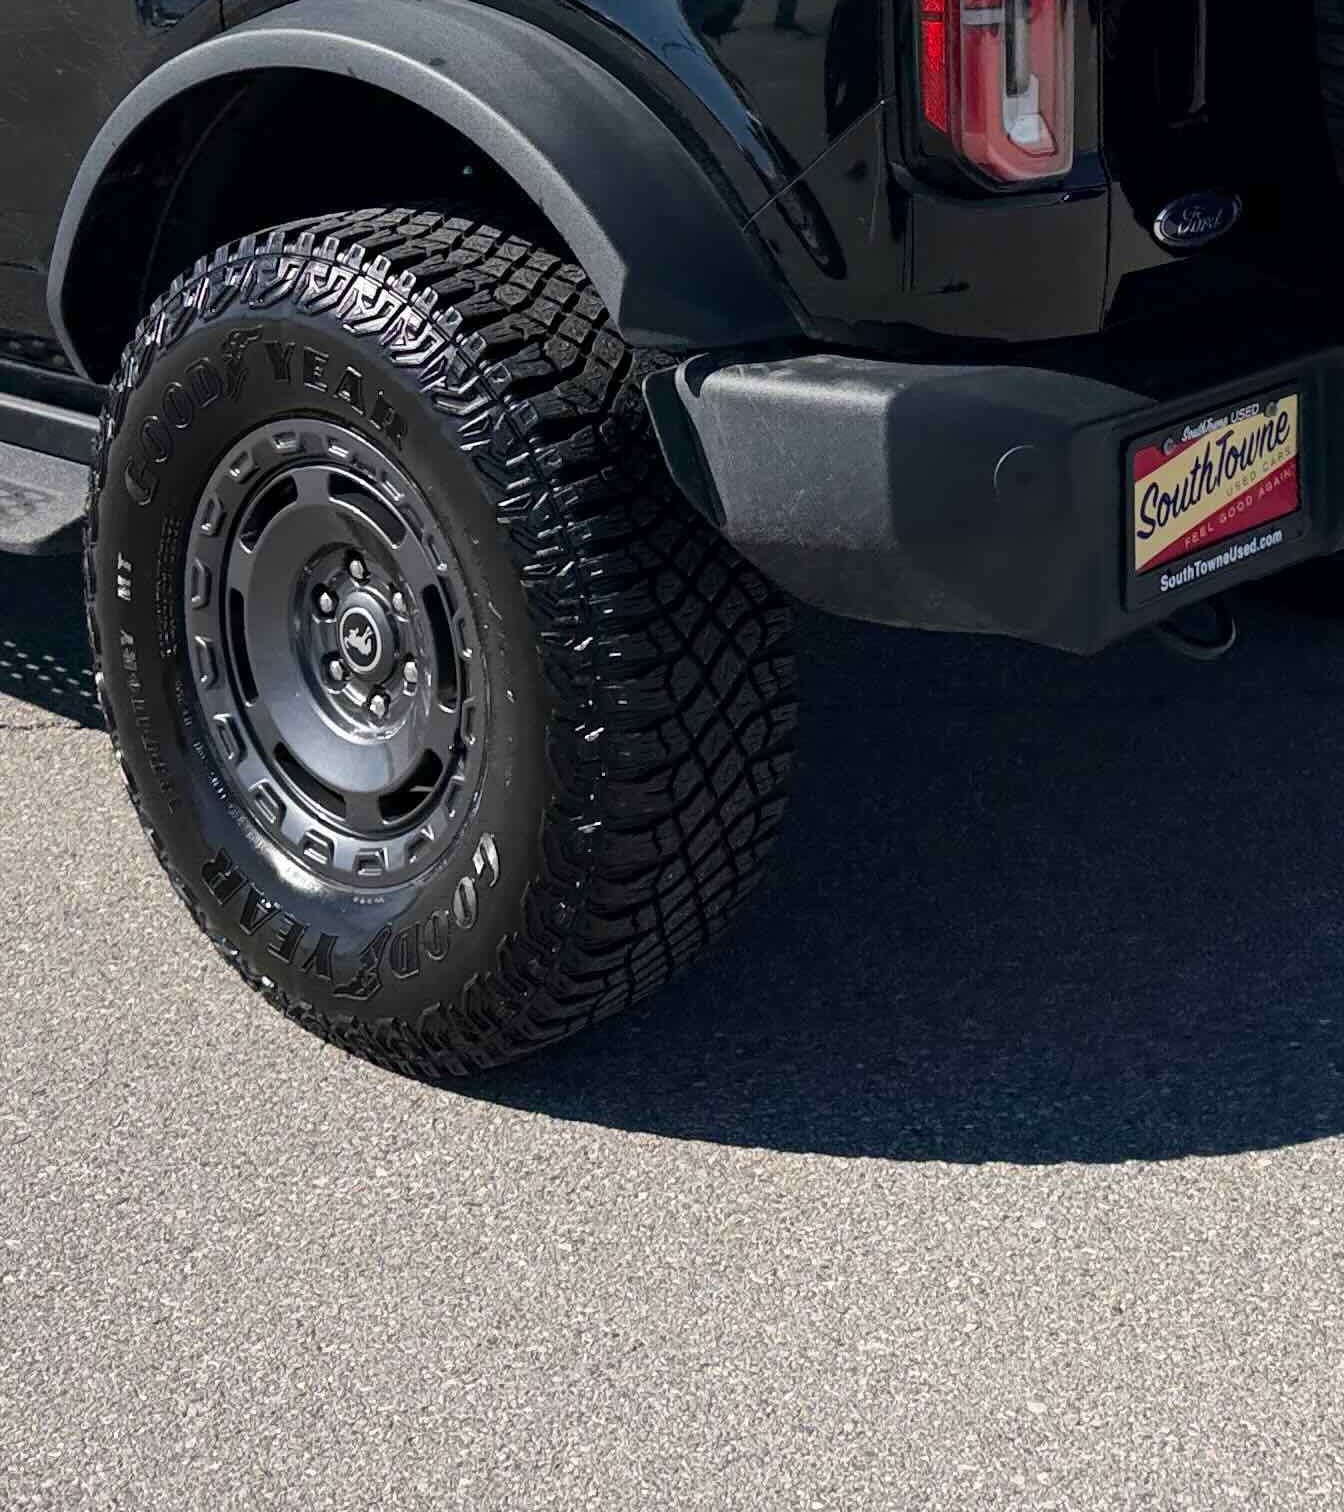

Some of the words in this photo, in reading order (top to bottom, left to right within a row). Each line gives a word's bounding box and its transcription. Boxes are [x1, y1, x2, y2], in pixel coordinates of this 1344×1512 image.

[123, 324, 410, 507] GOODYEAR
[1230, 402, 1261, 425] USED
[1136, 410, 1291, 540] SouthTowne
[1225, 470, 1257, 498] USED
[1262, 446, 1291, 472] CARS
[1184, 524, 1214, 552] FEEL
[1219, 496, 1254, 524] GOOD
[115, 550, 134, 603] MT
[1159, 528, 1283, 592] SouthTowneUsed.com
[200, 831, 501, 1001] GOODYEAR
